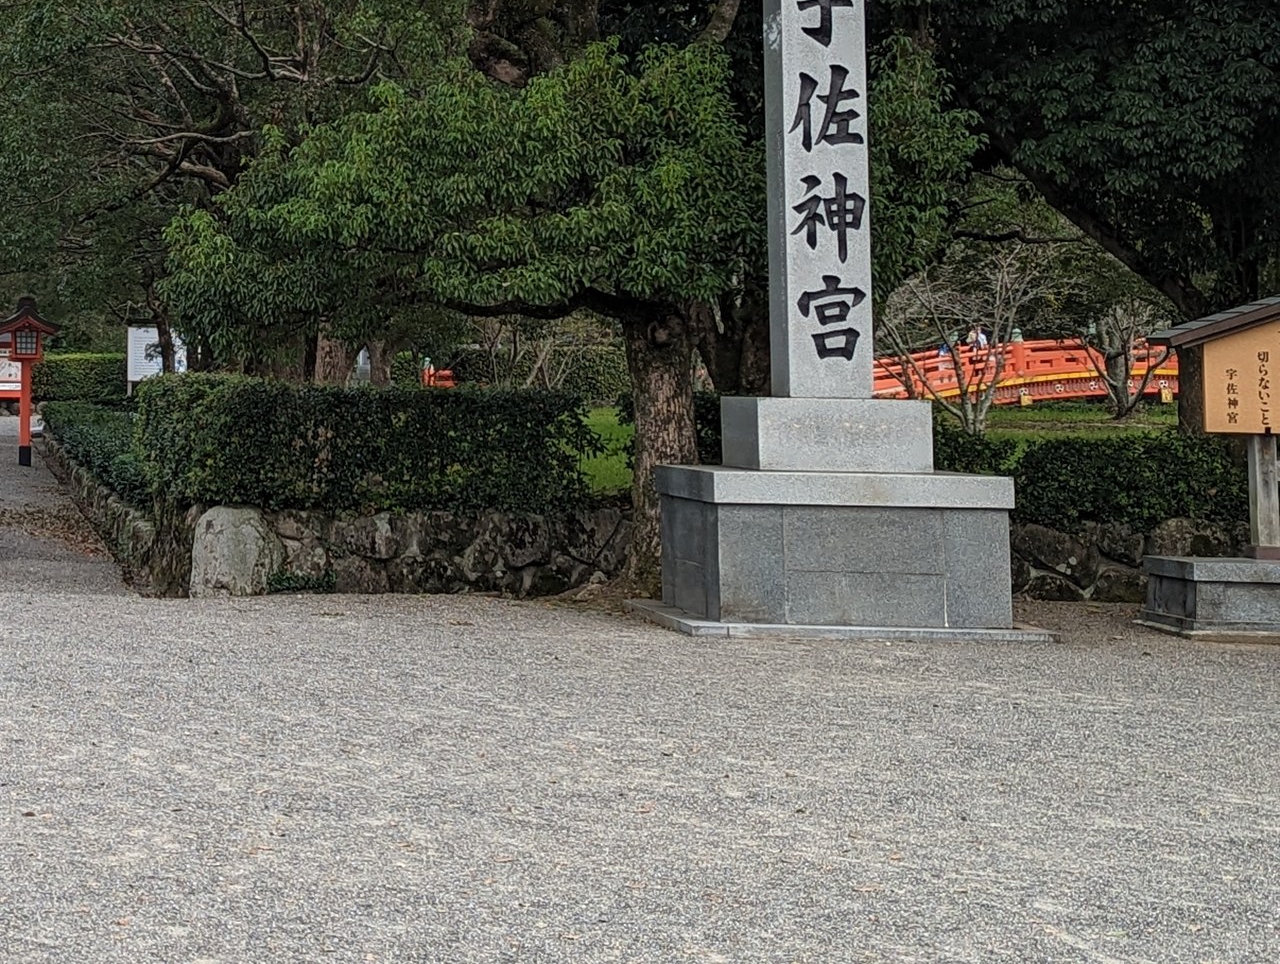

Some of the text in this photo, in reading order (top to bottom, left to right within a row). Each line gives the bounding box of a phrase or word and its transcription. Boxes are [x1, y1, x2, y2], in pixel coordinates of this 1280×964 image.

[1225, 368, 1239, 424] 宇佐神宮
[1257, 351, 1271, 425] 切らないこと
